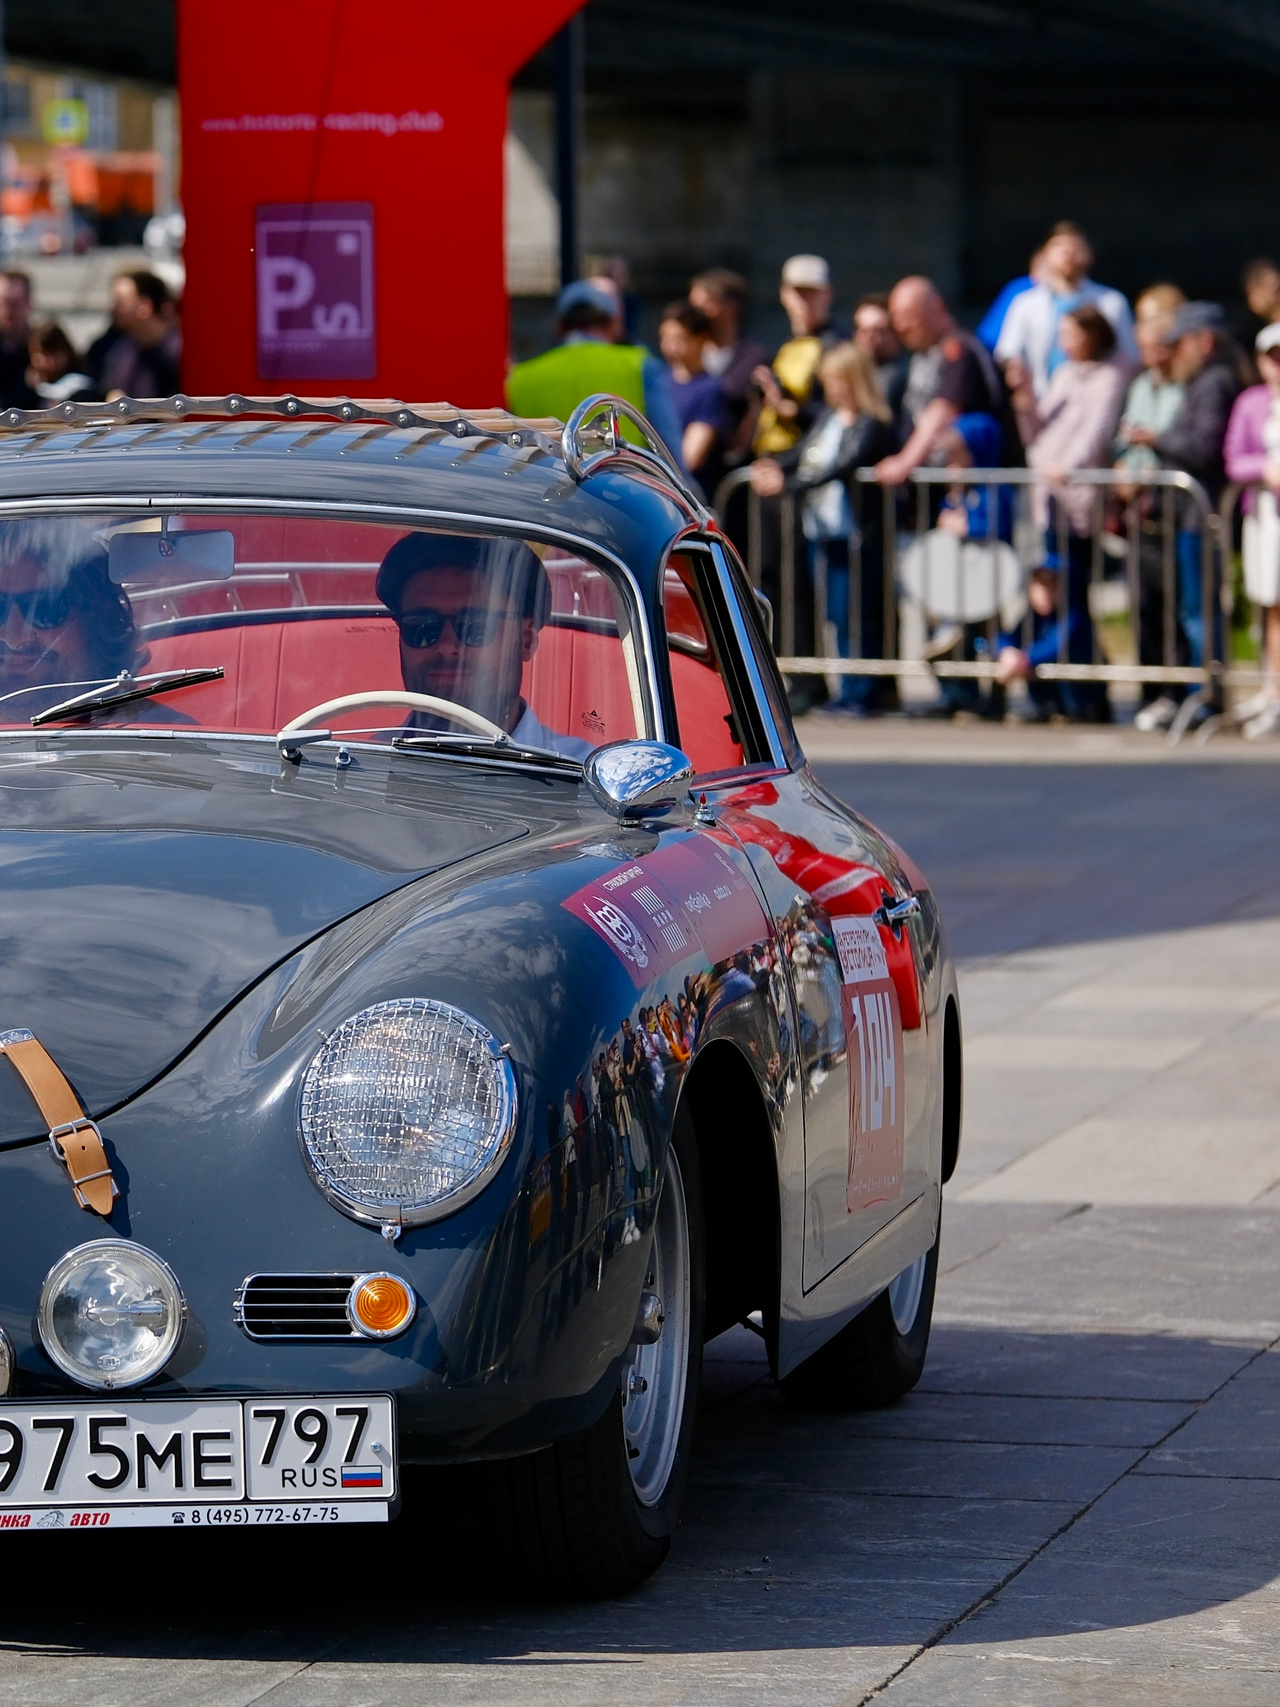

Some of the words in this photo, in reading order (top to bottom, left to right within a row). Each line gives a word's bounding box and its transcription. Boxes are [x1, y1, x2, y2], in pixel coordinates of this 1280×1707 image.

[252, 1406, 369, 1465] 797
[282, 1468, 338, 1488] RUS
[70, 1512, 111, 1527] авто
[191, 1510, 201, 1524] 8
[206, 1508, 249, 1524] (495)
[255, 1507, 339, 1522] 772-67-75
